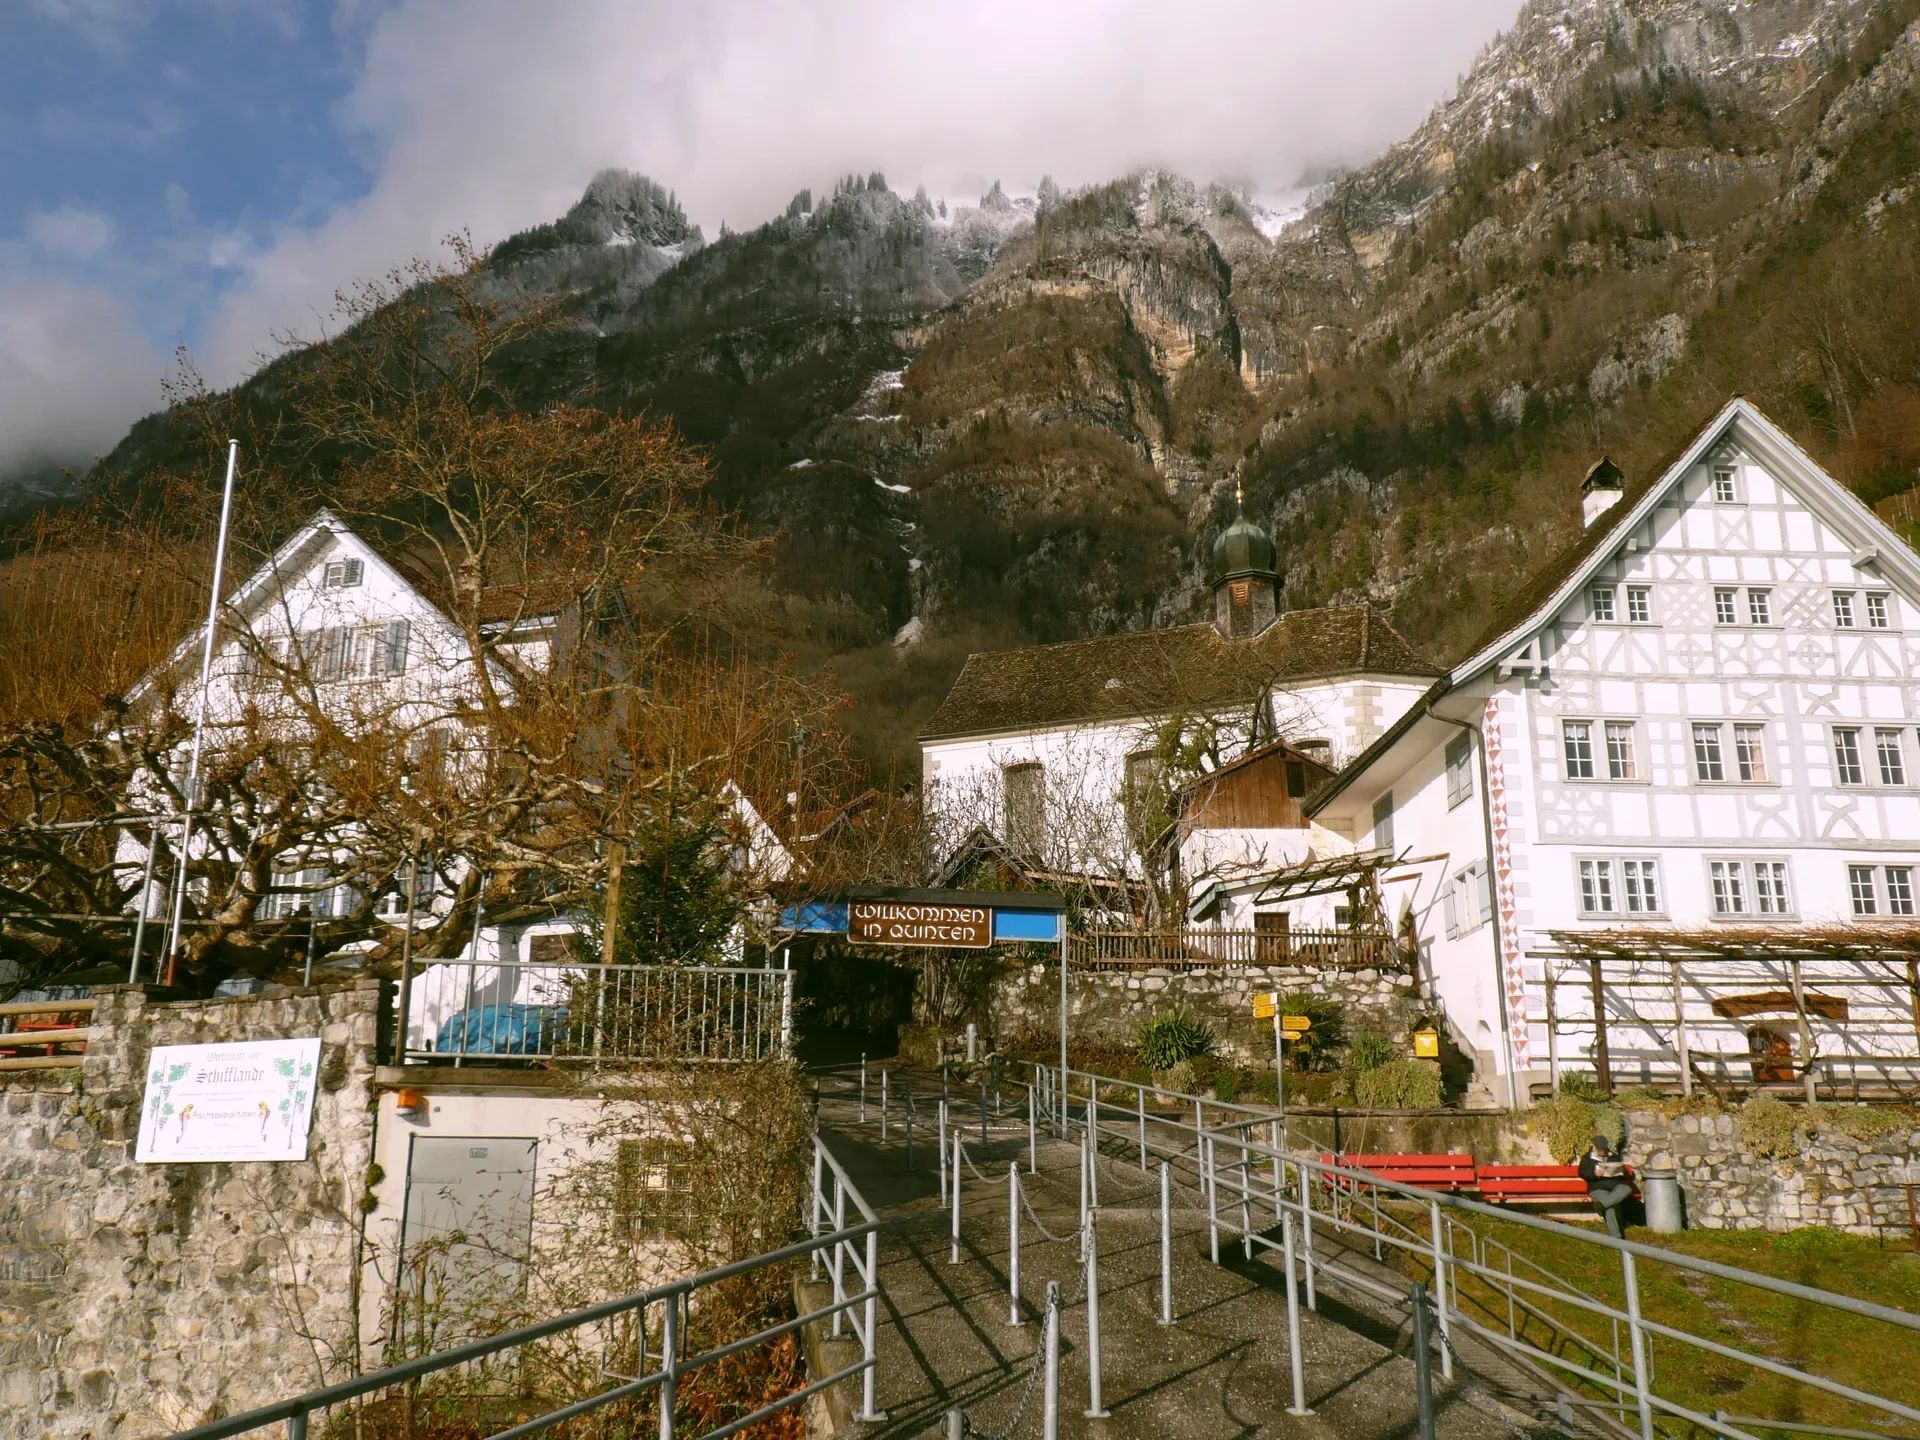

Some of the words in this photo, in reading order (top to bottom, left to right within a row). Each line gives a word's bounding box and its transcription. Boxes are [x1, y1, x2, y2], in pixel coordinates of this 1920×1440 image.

[855, 904, 985, 924] WILLKOMMEN
[863, 923, 882, 938] IN
[889, 924, 976, 941] QUINTEN
